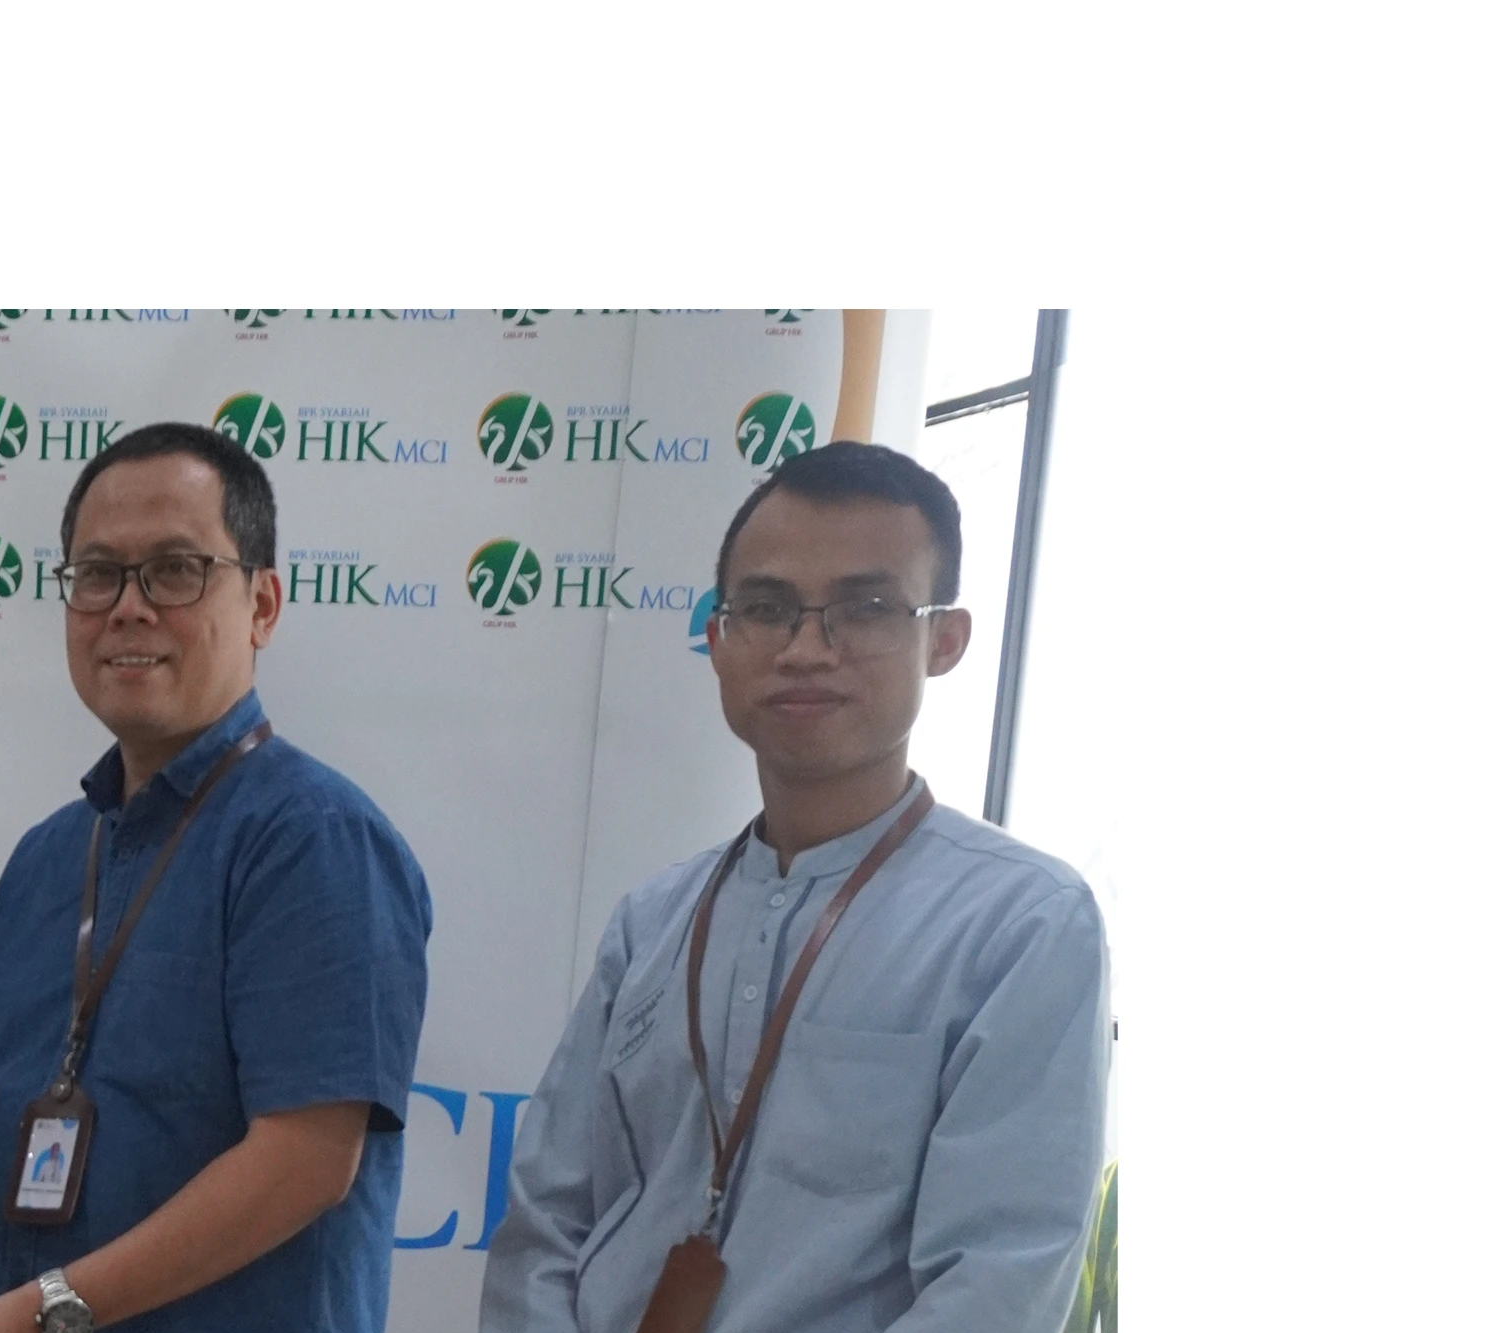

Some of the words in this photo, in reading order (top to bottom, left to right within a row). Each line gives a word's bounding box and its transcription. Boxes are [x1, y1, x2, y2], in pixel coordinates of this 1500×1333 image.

[654, 438, 708, 462] MCI
[289, 564, 379, 605] HIK
[385, 584, 436, 607] MCI
